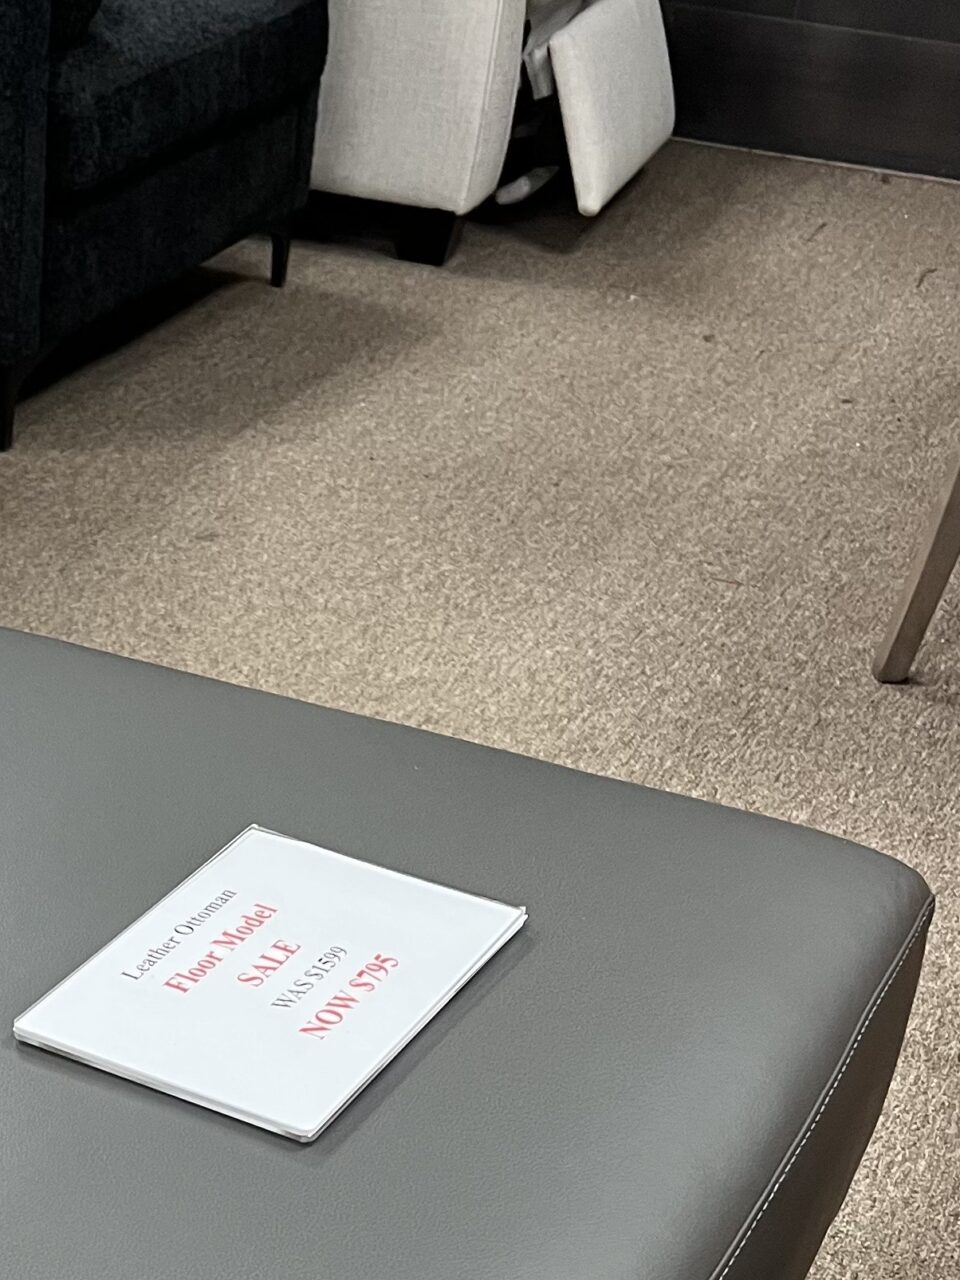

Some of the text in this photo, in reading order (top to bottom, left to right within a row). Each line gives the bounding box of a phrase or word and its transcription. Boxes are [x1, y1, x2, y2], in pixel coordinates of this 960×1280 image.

[120, 888, 238, 981] Leather Ottoman
[163, 903, 279, 995] Floor Model
[237, 939, 301, 987] SALE
[271, 945, 348, 1010] WAS $1599
[298, 953, 399, 1040] NOW $795
